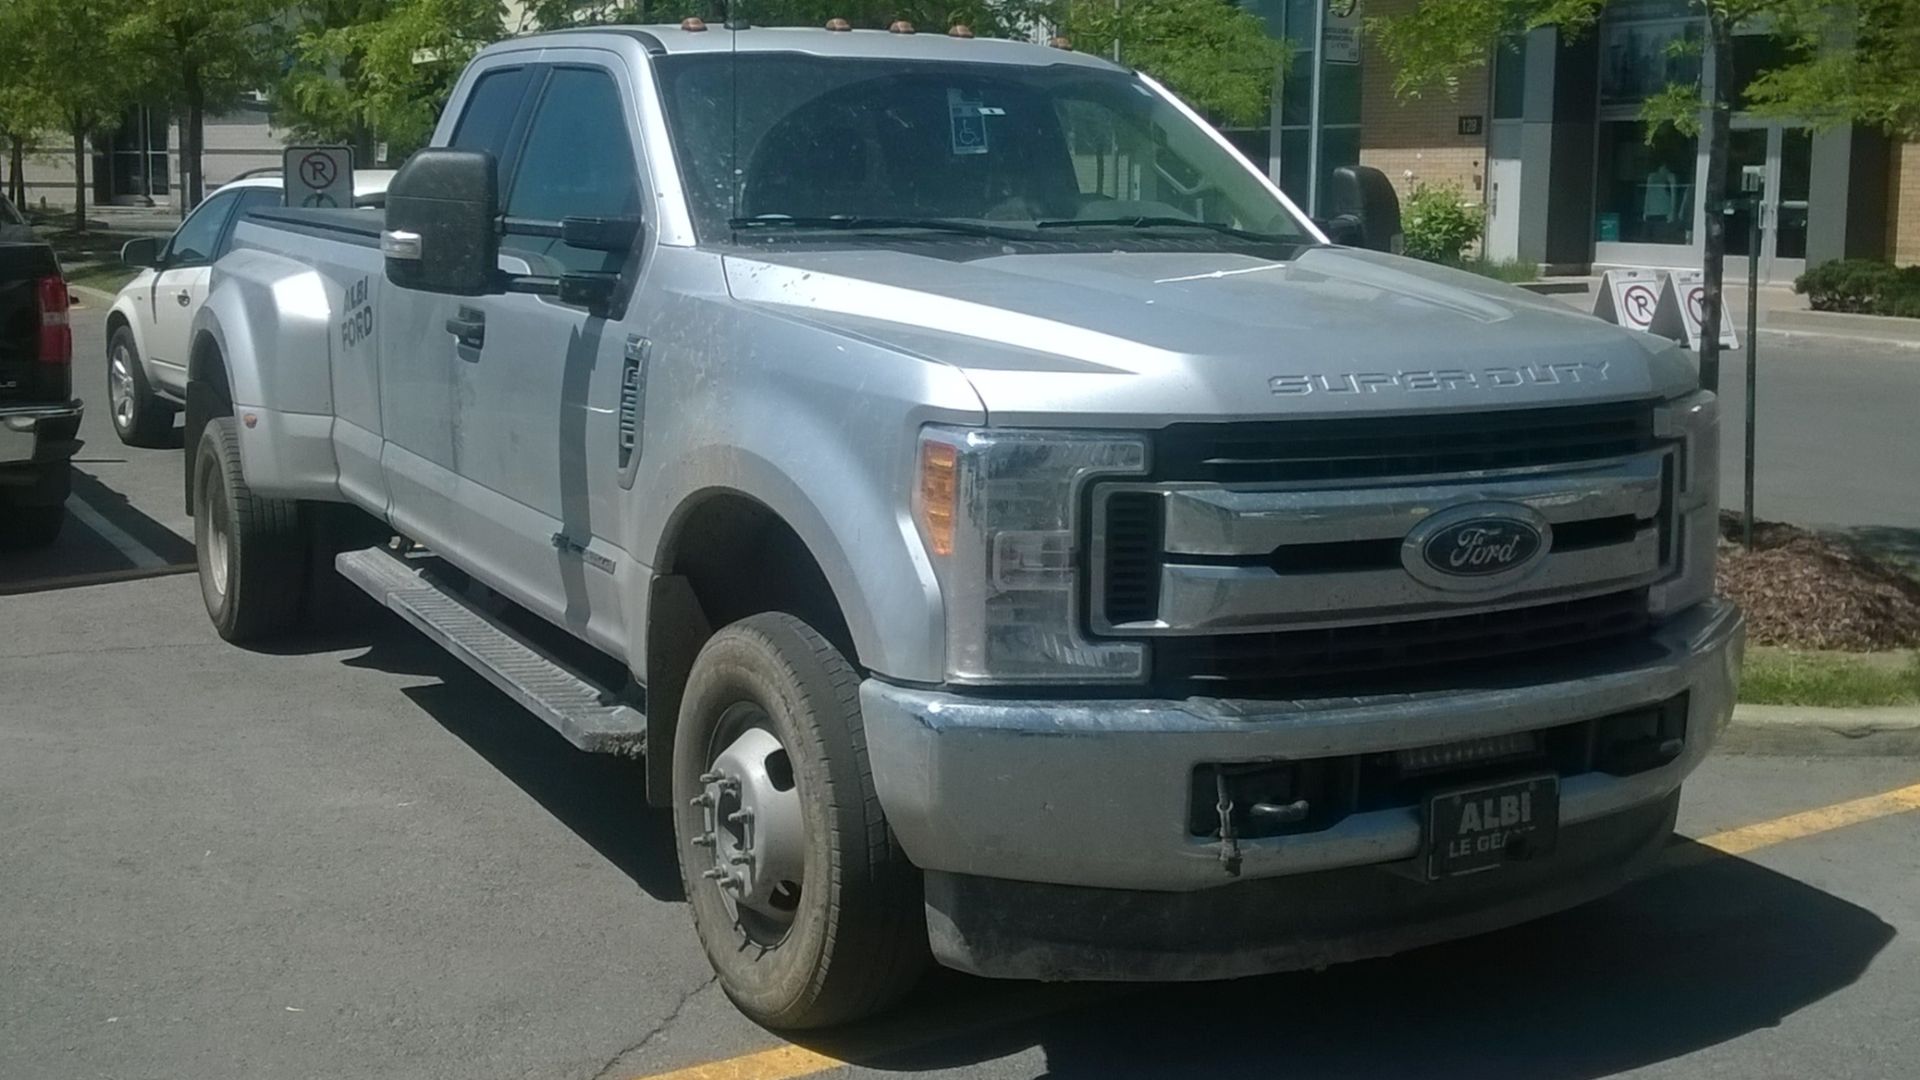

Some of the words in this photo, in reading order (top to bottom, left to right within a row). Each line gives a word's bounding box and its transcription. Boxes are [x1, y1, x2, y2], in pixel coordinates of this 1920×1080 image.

[343, 274, 369, 316] ALBI
[341, 305, 373, 352] FORD
[1268, 368, 1480, 396] SUPER
[1483, 359, 1611, 388] DUTY
[1449, 527, 1521, 567] Ford
[1458, 791, 1531, 835] ALBI
[1448, 837, 1472, 858] LE
